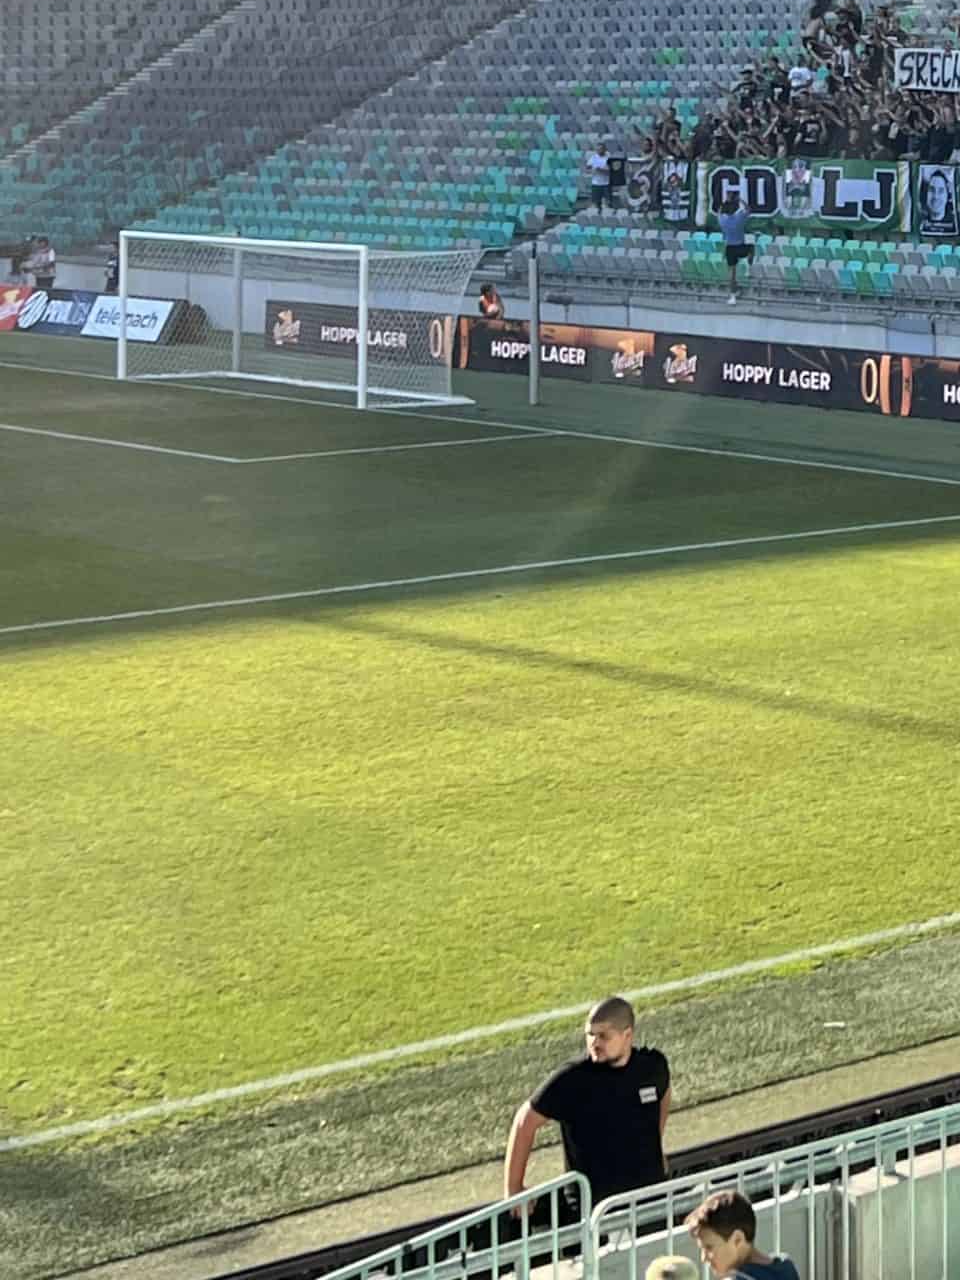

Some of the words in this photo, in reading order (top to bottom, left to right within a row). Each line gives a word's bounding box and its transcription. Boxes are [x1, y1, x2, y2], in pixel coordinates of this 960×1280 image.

[367, 329, 408, 348] LAGER
[541, 345, 586, 365] LAGER
[722, 363, 773, 384] HOPPY
[778, 368, 831, 390] LAGER
